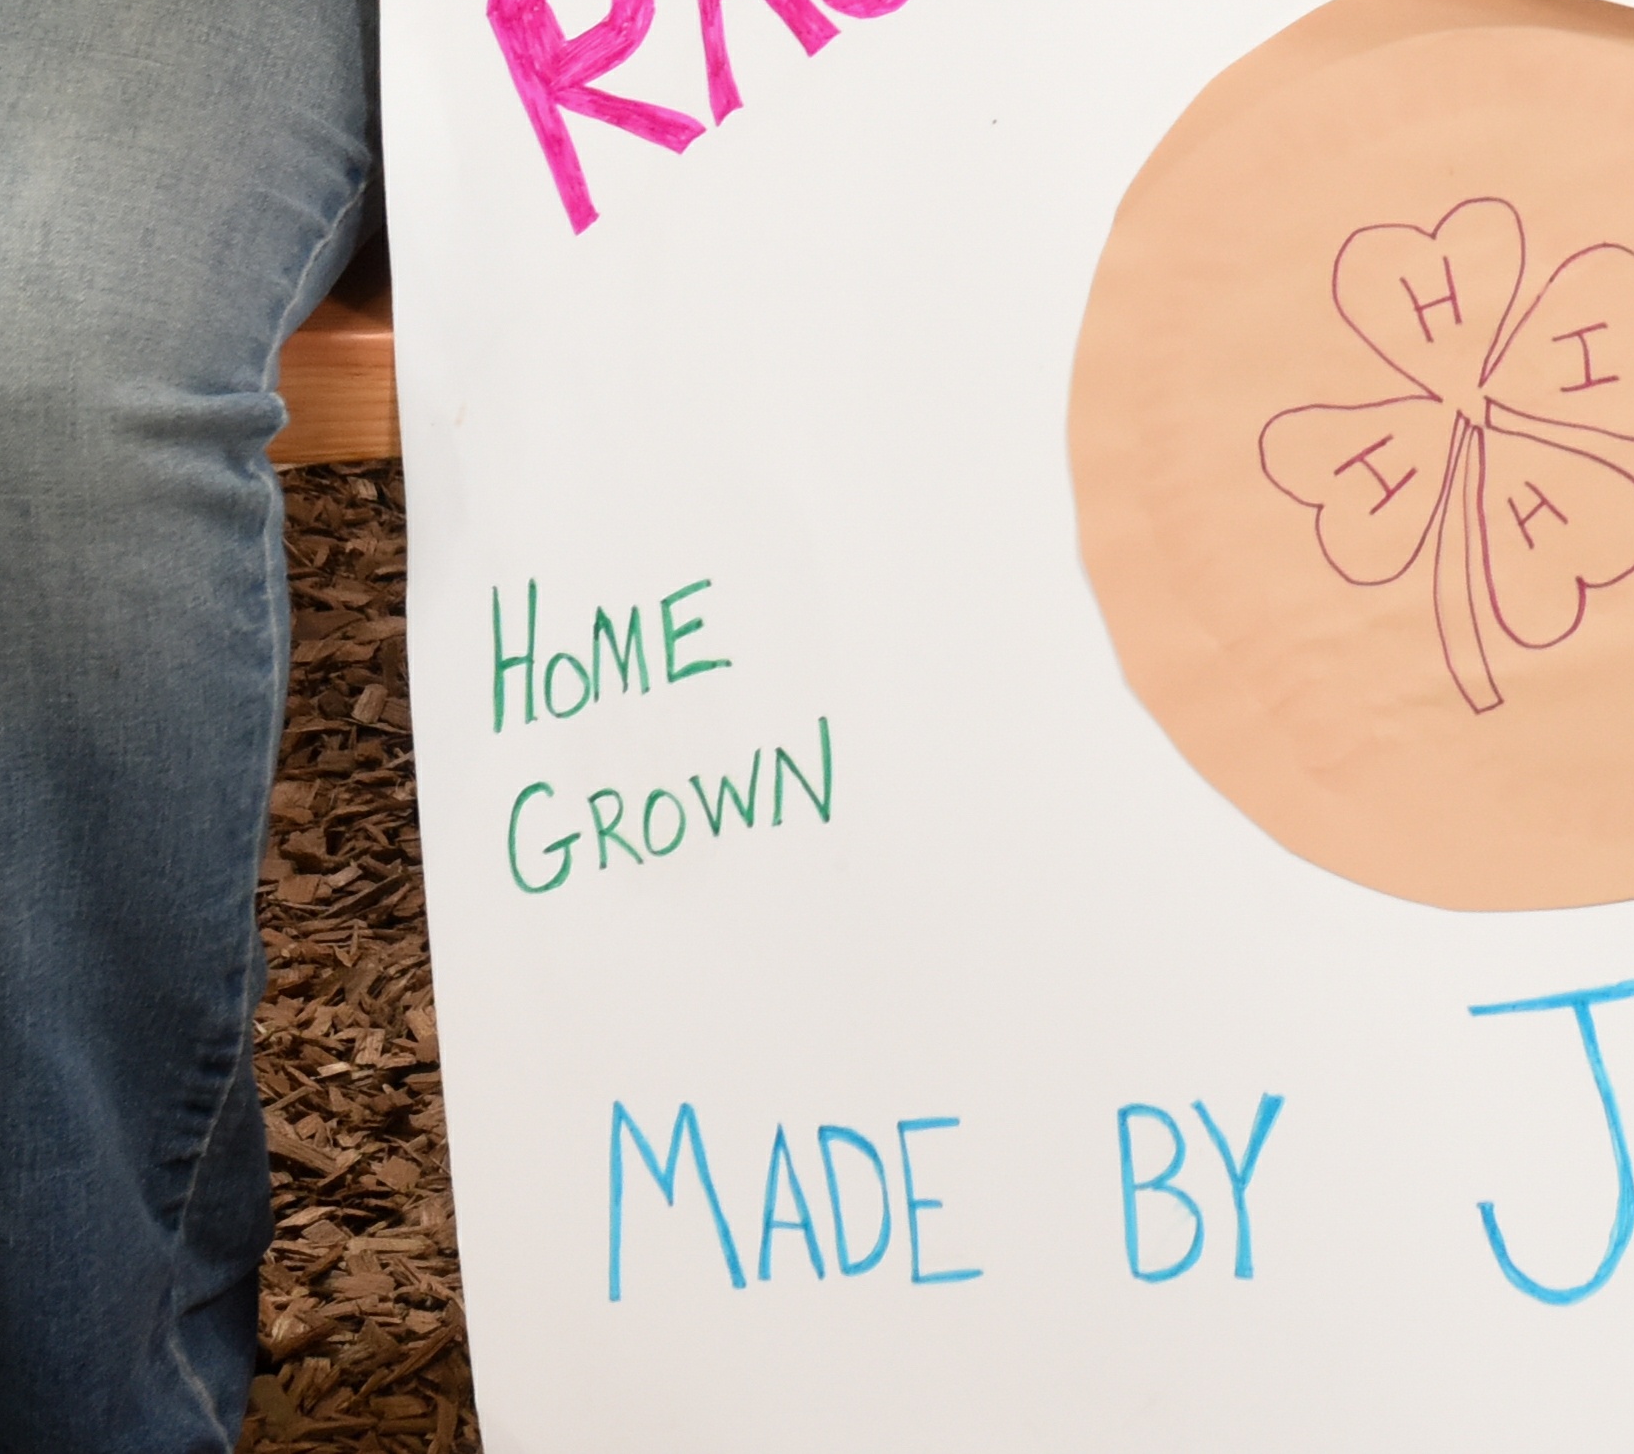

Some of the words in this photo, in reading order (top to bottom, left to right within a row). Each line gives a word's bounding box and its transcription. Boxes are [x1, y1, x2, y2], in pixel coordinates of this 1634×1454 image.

[508, 715, 833, 894] GROWN
[609, 1100, 983, 1302] MADE
[1117, 1092, 1285, 1285] BY
